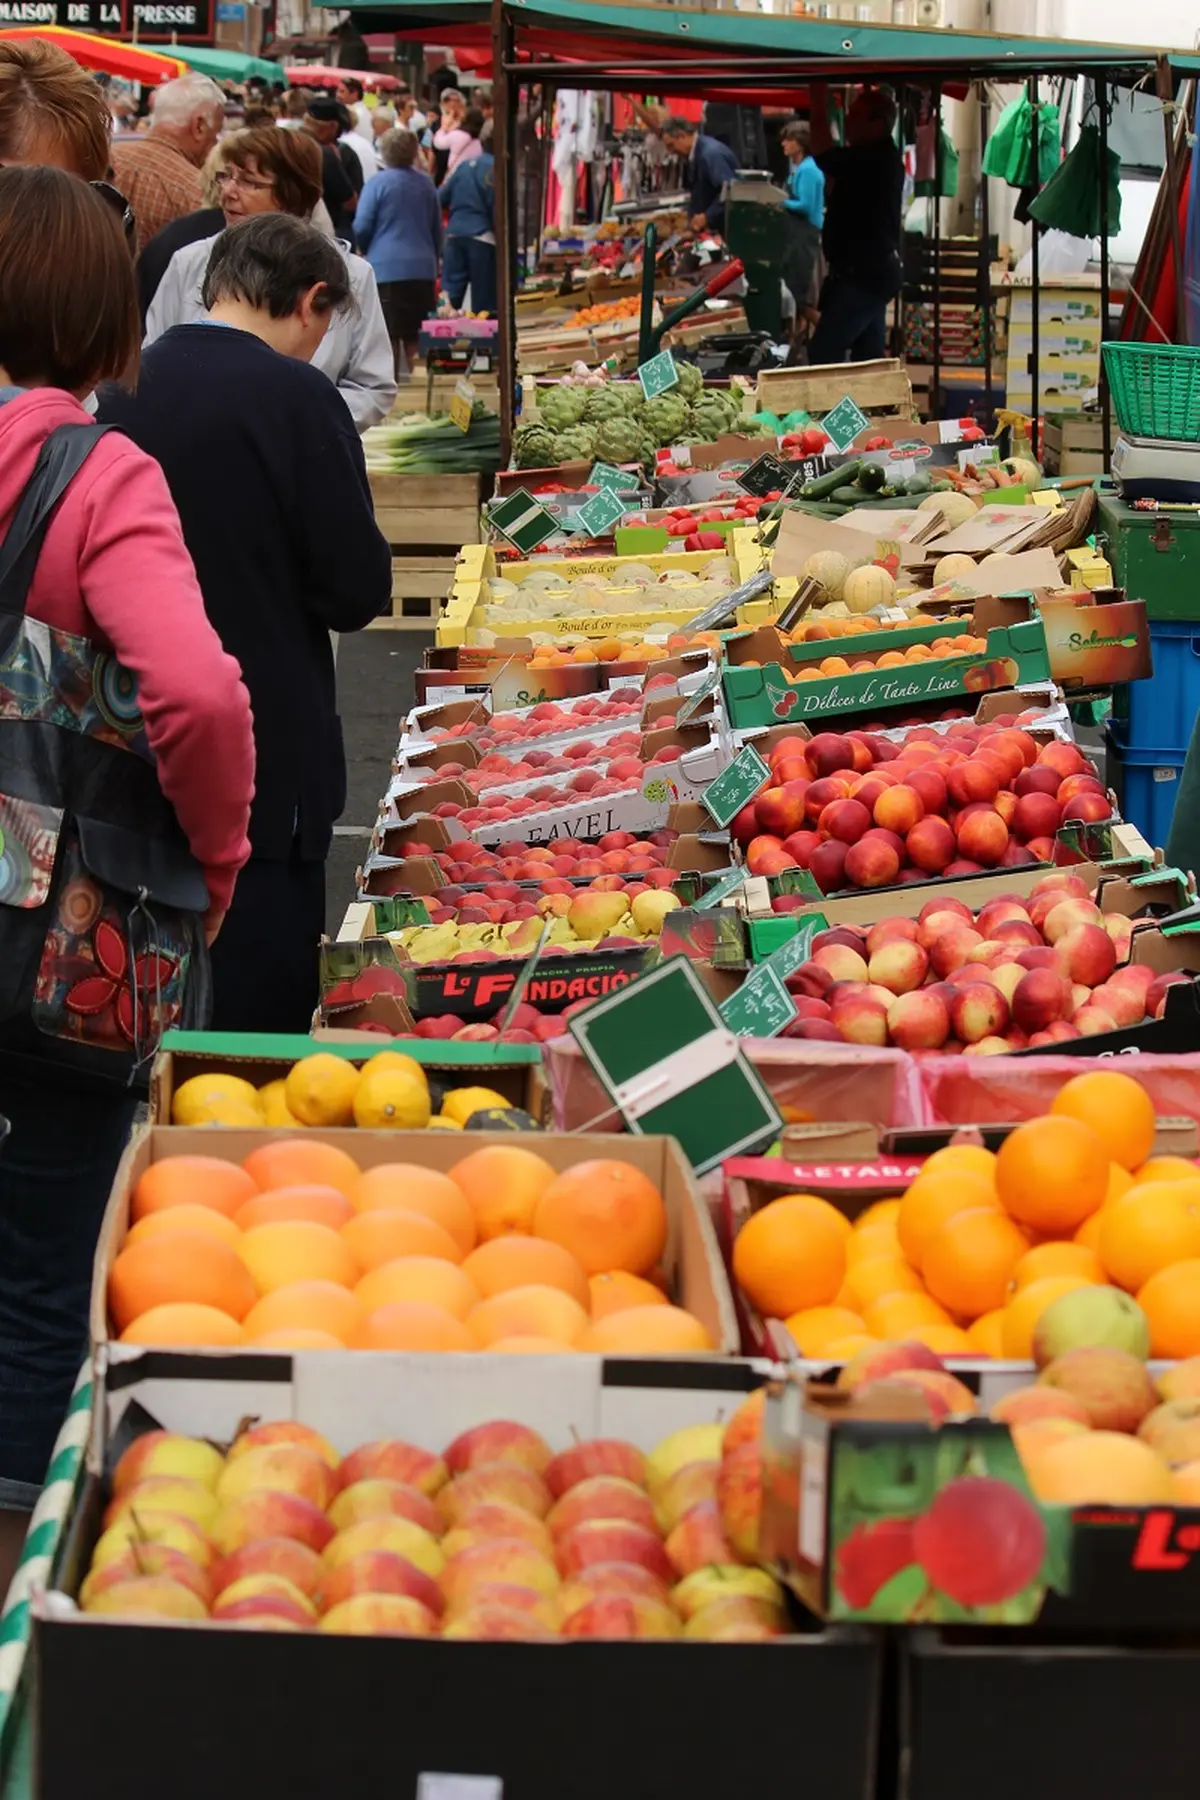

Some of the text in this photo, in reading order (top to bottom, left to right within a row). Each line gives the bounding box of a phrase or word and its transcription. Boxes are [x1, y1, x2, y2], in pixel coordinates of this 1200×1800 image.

[67, 4, 90, 22] DE
[100, 4, 121, 22] LA
[133, 5, 196, 24] PRESSE
[566, 564, 597, 576] Boule
[557, 620, 589, 633] Boule
[803, 675, 960, 712] Délices de Tante Line
[473, 969, 641, 1008] FNDACIÓ
